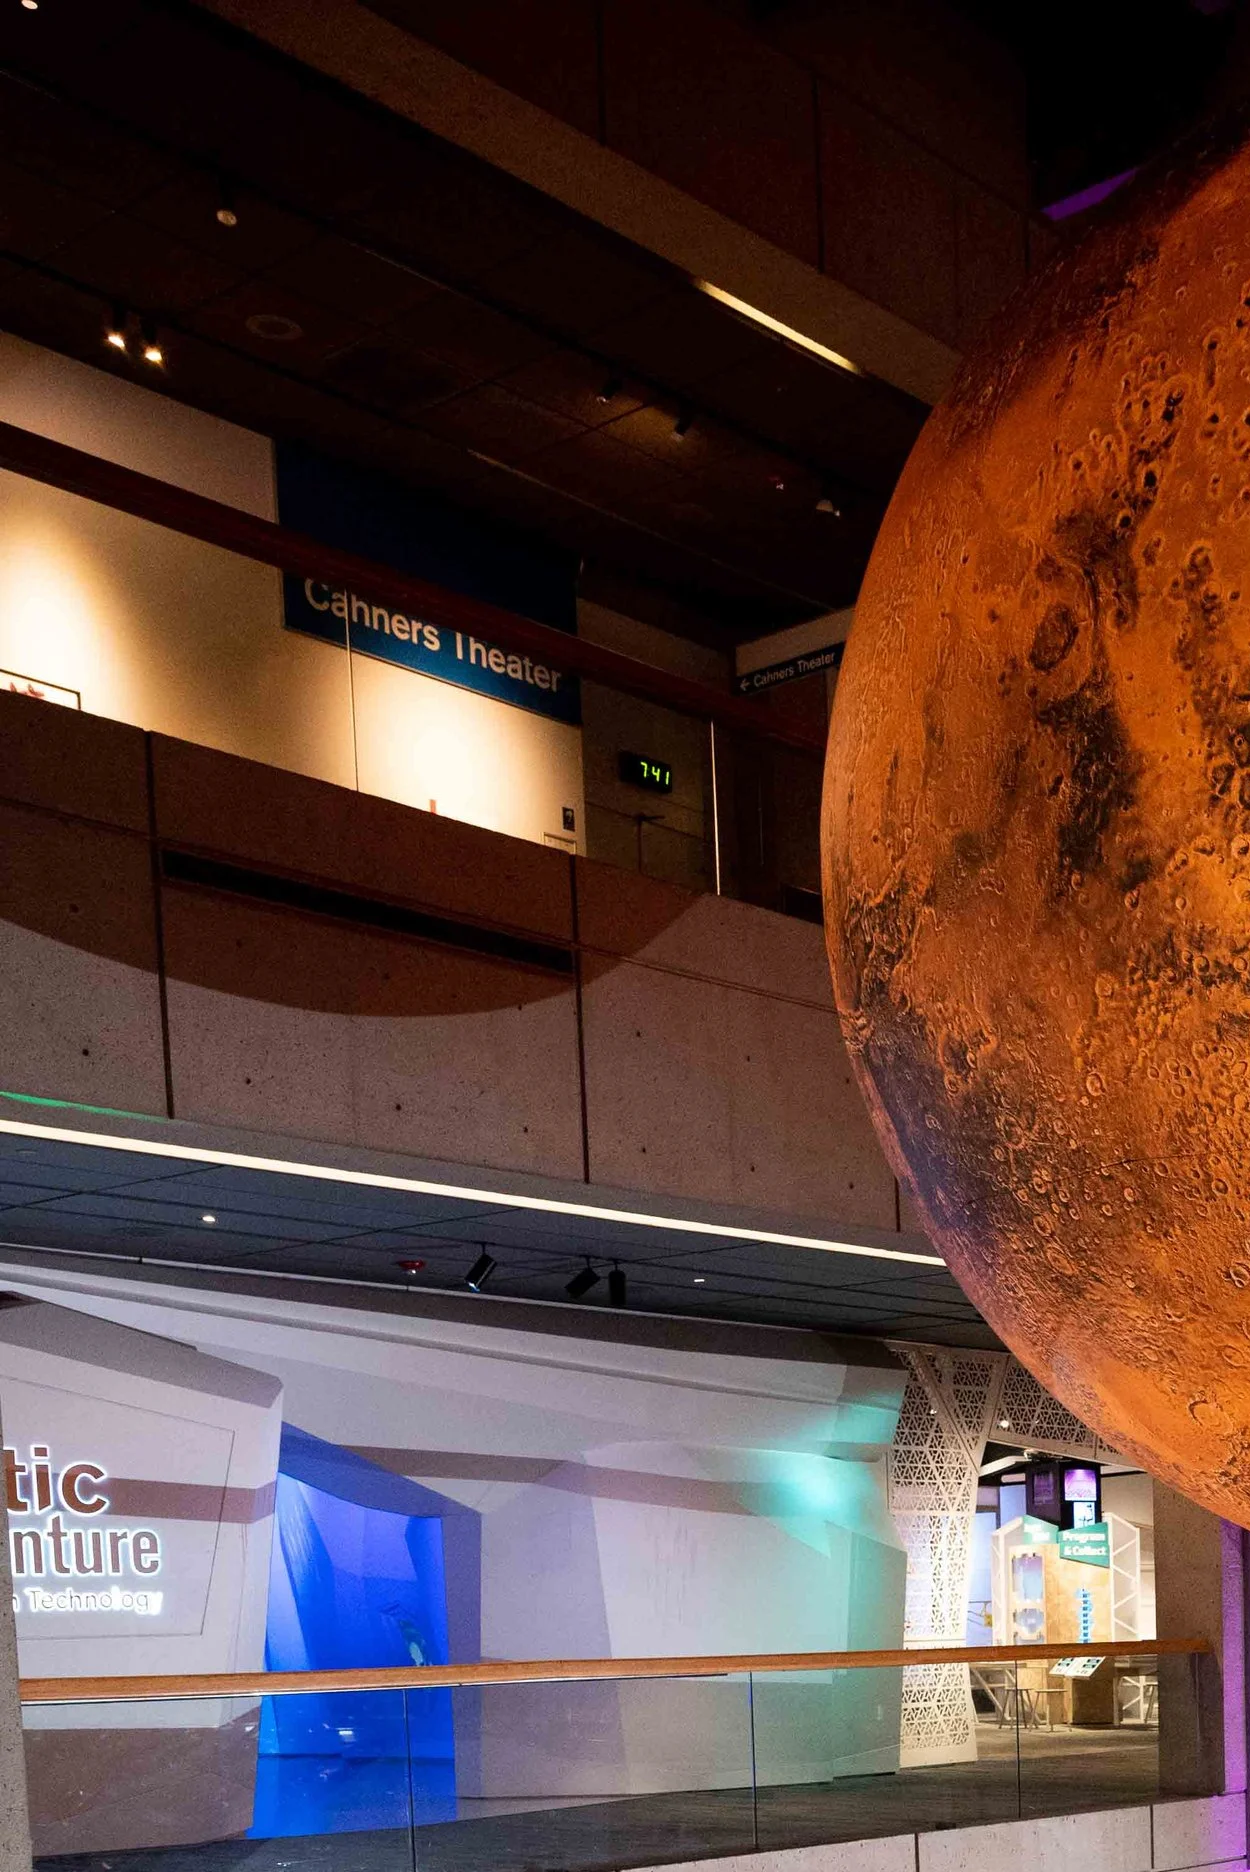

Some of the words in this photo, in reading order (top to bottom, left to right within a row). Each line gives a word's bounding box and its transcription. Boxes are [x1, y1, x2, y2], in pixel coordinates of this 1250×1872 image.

[304, 578, 441, 651] Cahners
[753, 666, 794, 687] Cahners
[798, 652, 836, 673] Theater
[4, 1445, 108, 1514] tic
[12, 1514, 160, 1575] nture
